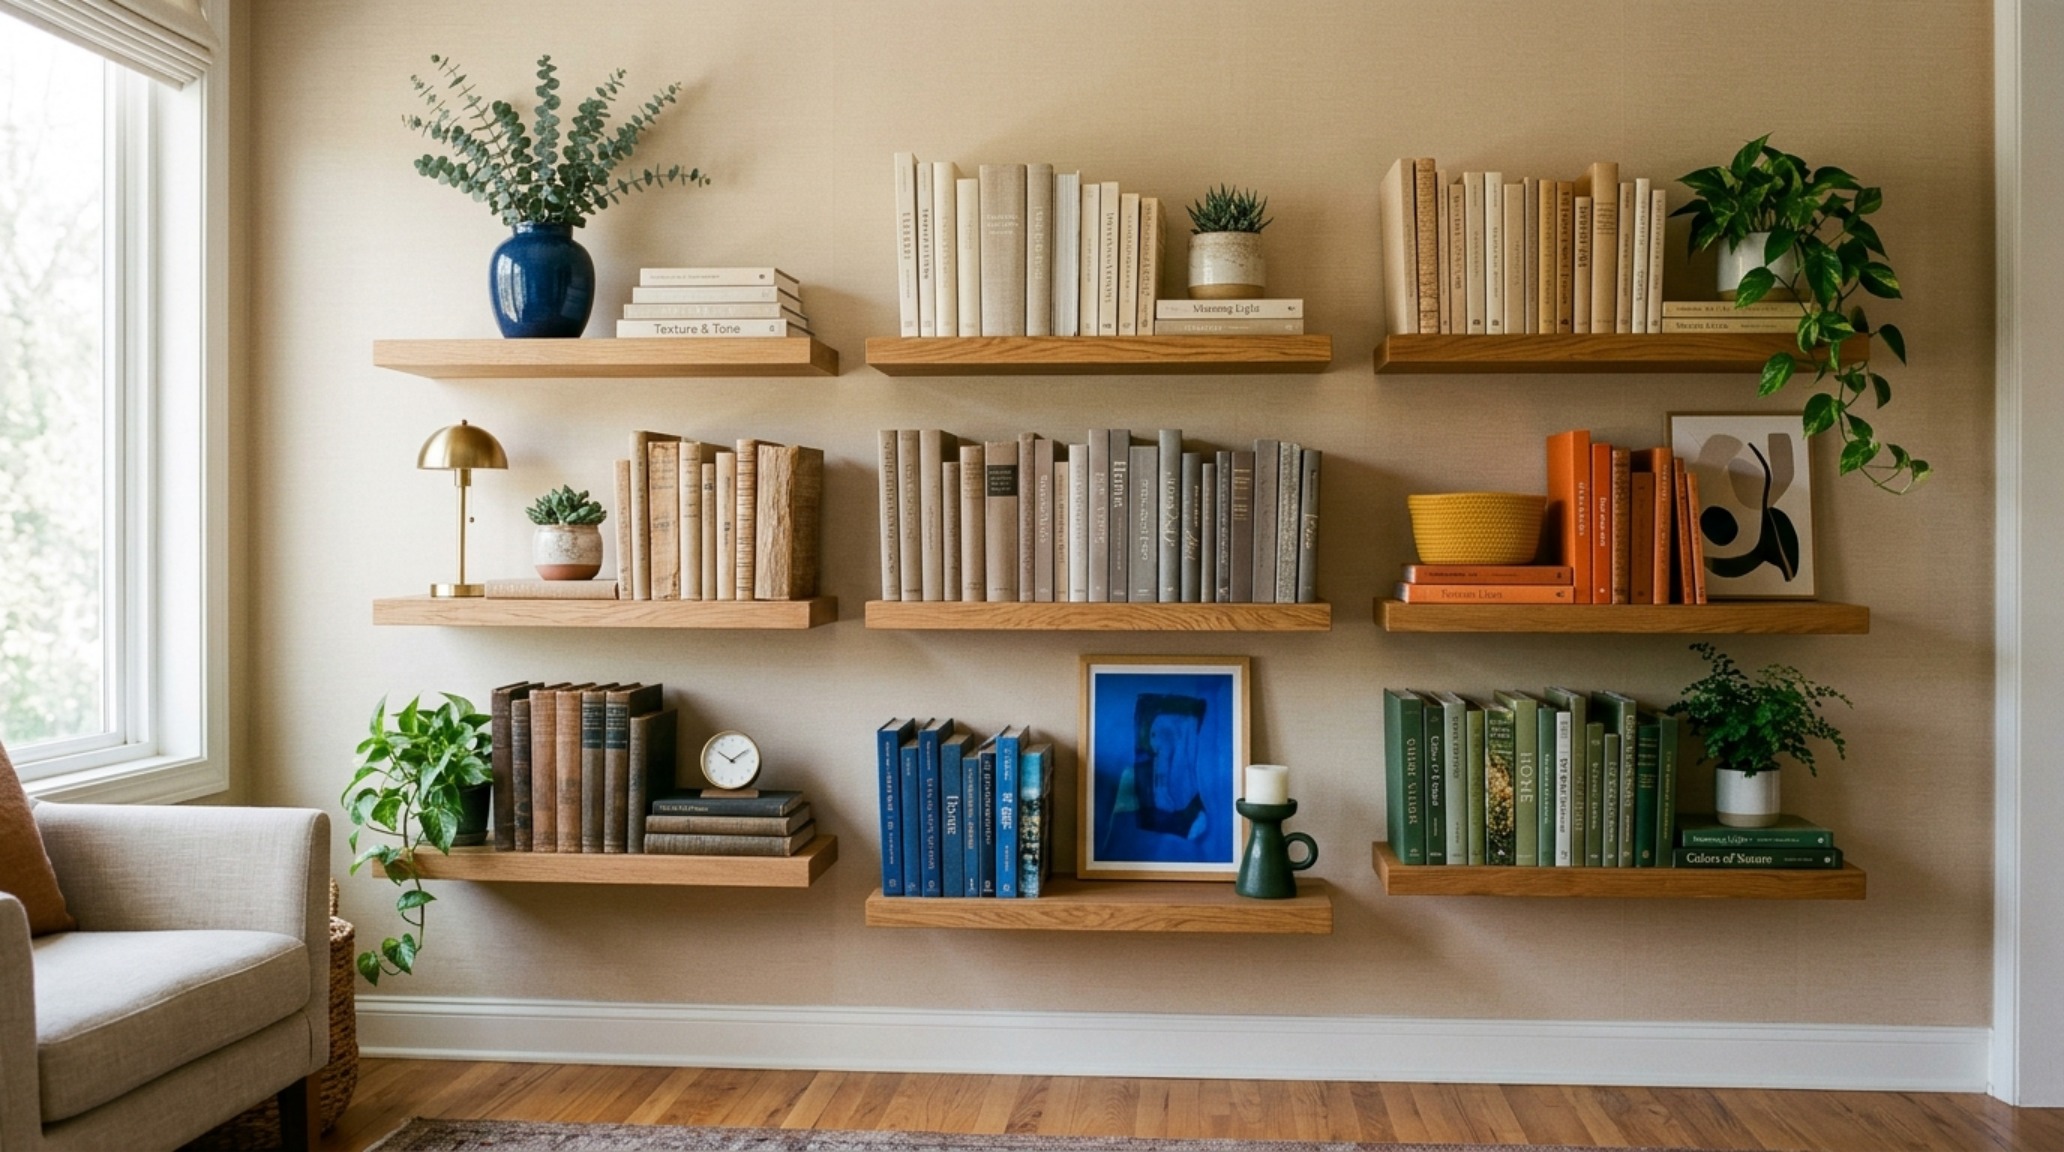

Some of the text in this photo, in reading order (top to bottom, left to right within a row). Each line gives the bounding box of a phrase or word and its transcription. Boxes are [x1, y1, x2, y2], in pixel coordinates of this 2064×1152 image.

[654, 323, 741, 335] Texture & Tone
